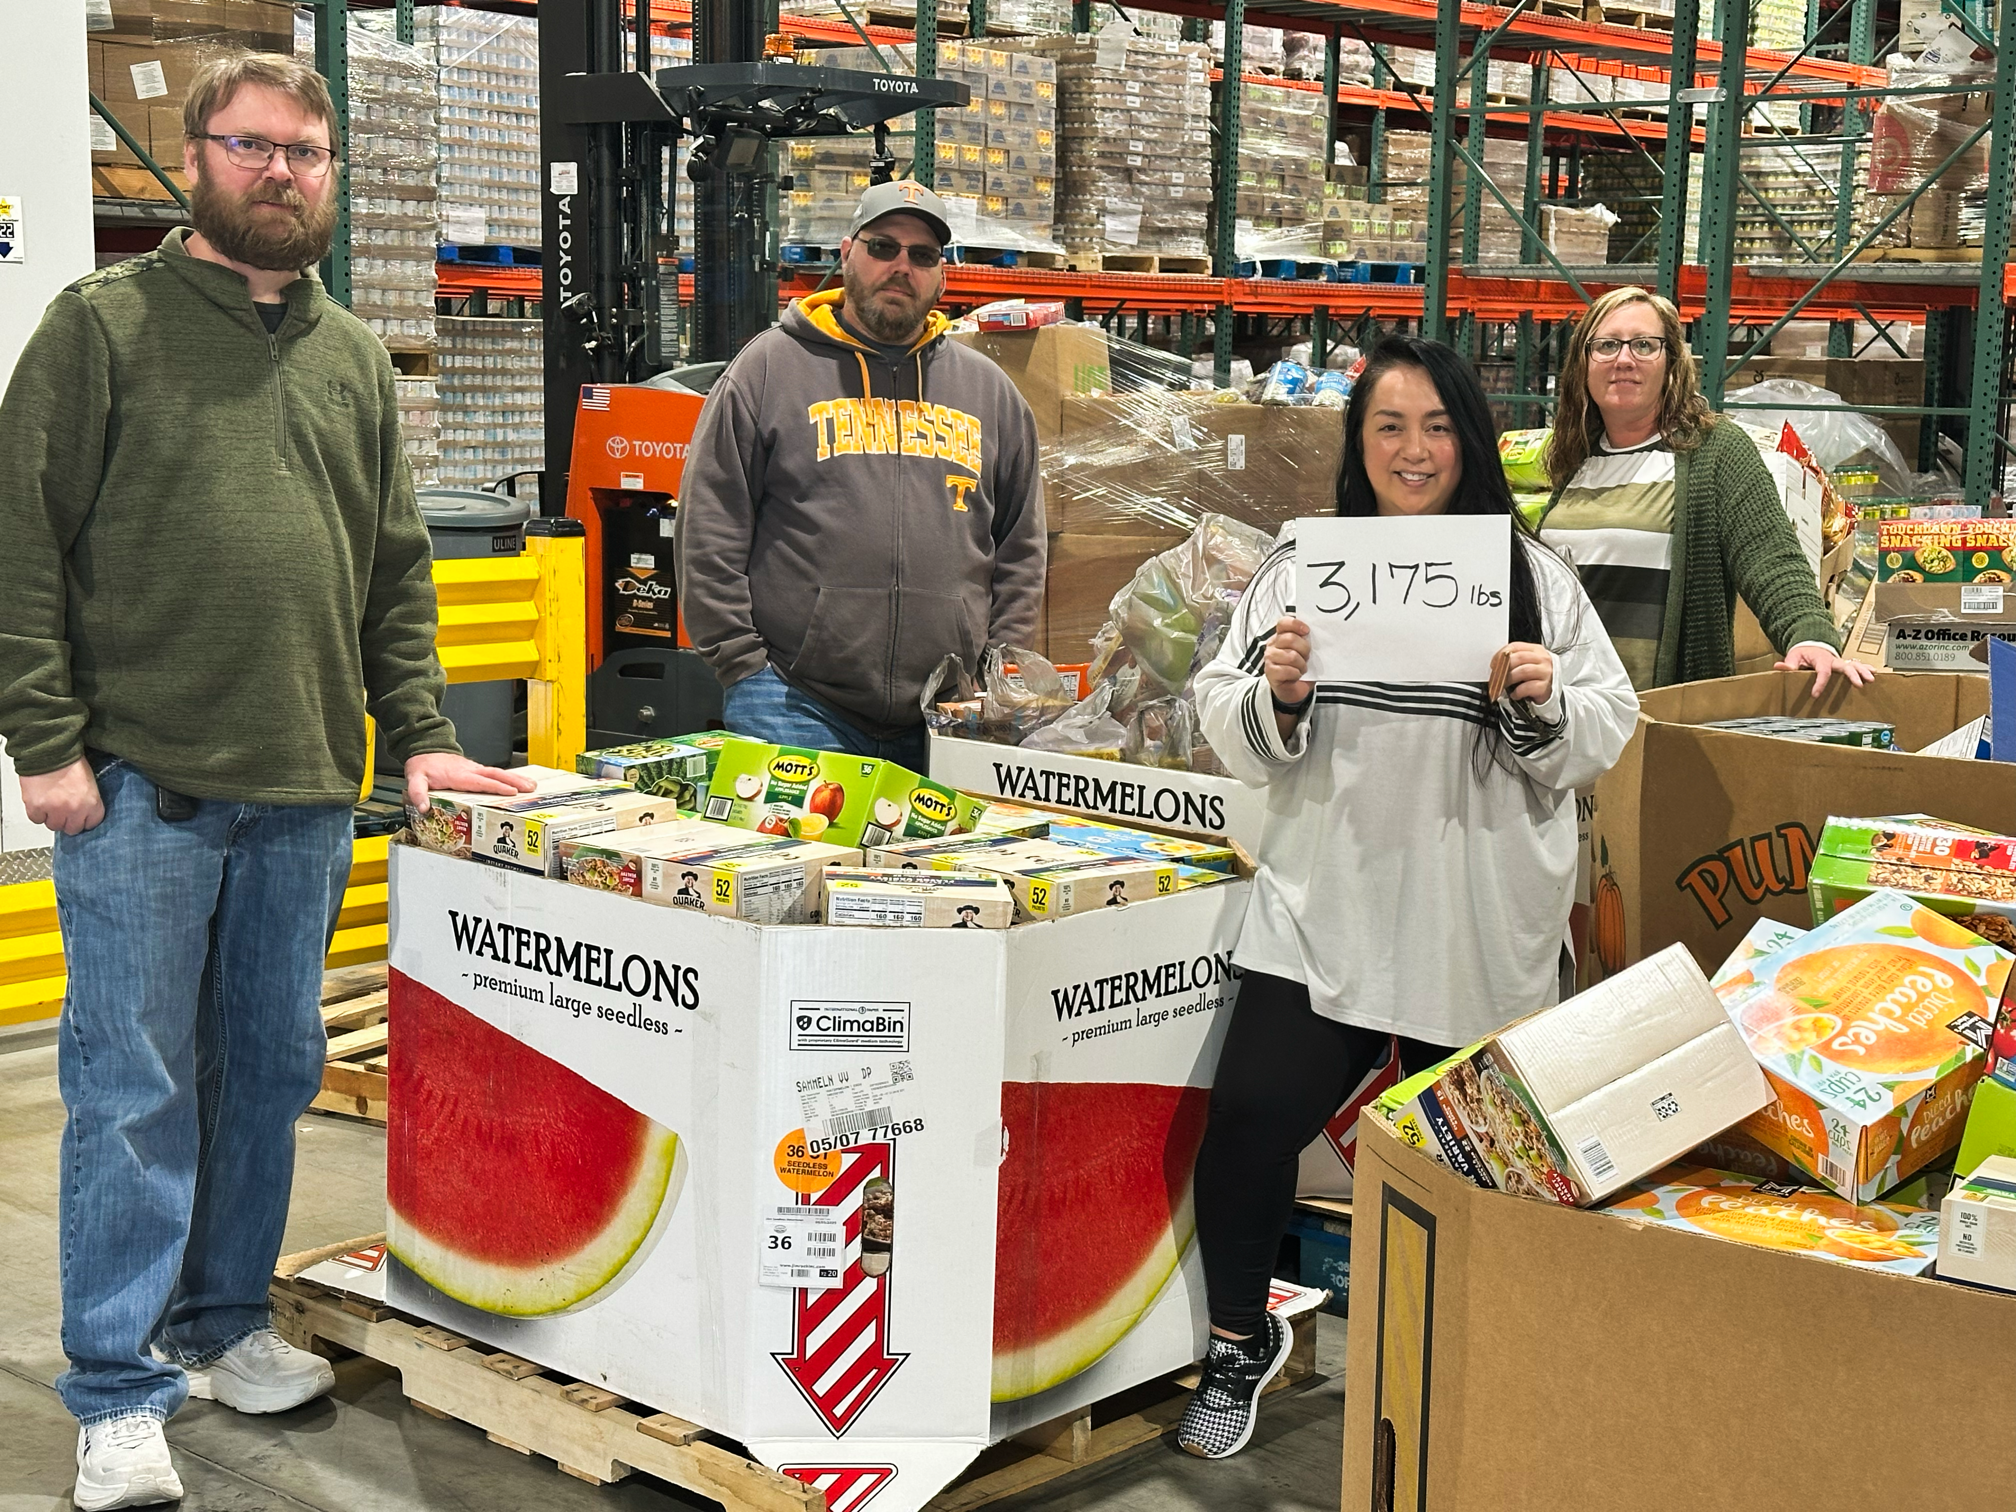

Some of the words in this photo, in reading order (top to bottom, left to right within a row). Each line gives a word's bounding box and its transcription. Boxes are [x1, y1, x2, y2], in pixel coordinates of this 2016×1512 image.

[872, 79, 919, 95] TOYOTA
[898, 183, 924, 205] T
[558, 195, 572, 302] TOYOTA
[808, 397, 982, 478] TENNESSEE
[633, 440, 691, 459] TOYOTA
[945, 474, 978, 512] T
[493, 537, 516, 551] ULINE
[1880, 535, 1961, 548] SNACKING
[614, 577, 671, 599] Deka
[1307, 561, 1459, 621] 3,175
[1471, 584, 1502, 607] lbs
[1896, 629, 1922, 641] A-Z
[1924, 628, 1967, 642] Office
[1895, 643, 1970, 652] www.azorinc.com
[1895, 652, 1956, 662] 800.851.0189
[862, 764, 872, 774] 36
[778, 781, 791, 789] Sugar
[992, 762, 1225, 830] WATERMELONS
[910, 811, 917, 819] No
[917, 815, 931, 825] Sugar
[931, 820, 946, 830] Added
[527, 829, 539, 848] 52
[1932, 836, 1951, 856] 30
[493, 844, 520, 860] QUAKER
[715, 879, 730, 898] 52
[1158, 875, 1171, 893] 52
[673, 896, 707, 911] QUAKER
[1032, 886, 1047, 906] 52
[448, 910, 700, 1010] WATERMELONS
[473, 972, 544, 1003] premium
[549, 982, 592, 1018] large
[597, 1003, 669, 1035] seedless
[1831, 966, 1955, 1056] Peaches
[1906, 991, 1958, 1029] Diced
[816, 1015, 904, 1032] ClimaBin
[1072, 1017, 1133, 1048] premium
[1136, 1008, 1169, 1028] large
[1173, 993, 1224, 1018] seedless
[796, 1074, 835, 1093] SAMMELN
[861, 1066, 872, 1080] DP
[1818, 1071, 1861, 1100] cups
[1435, 1088, 1445, 1101] 15
[1843, 1087, 1882, 1110] 24
[1923, 1091, 1951, 1124] Diced
[810, 1130, 861, 1154] 05/07
[868, 1118, 925, 1141] 77668
[1399, 1119, 1423, 1147] 52
[1831, 1118, 1849, 1138] 24
[1434, 1114, 1470, 1172] VARIETY
[1460, 1138, 1471, 1152] 22
[1828, 1130, 1852, 1151] cups
[786, 1144, 805, 1158] 36
[779, 1167, 834, 1178] WATERMELON
[787, 1160, 828, 1170] SEEDLESS
[1551, 1178, 1568, 1201] HEART
[1552, 1171, 1574, 1203] HEALTHY
[1700, 1194, 1879, 1233] Peaches
[1960, 1211, 1978, 1222] 100%
[767, 1235, 792, 1250] 36
[1962, 1233, 1972, 1242] NO
